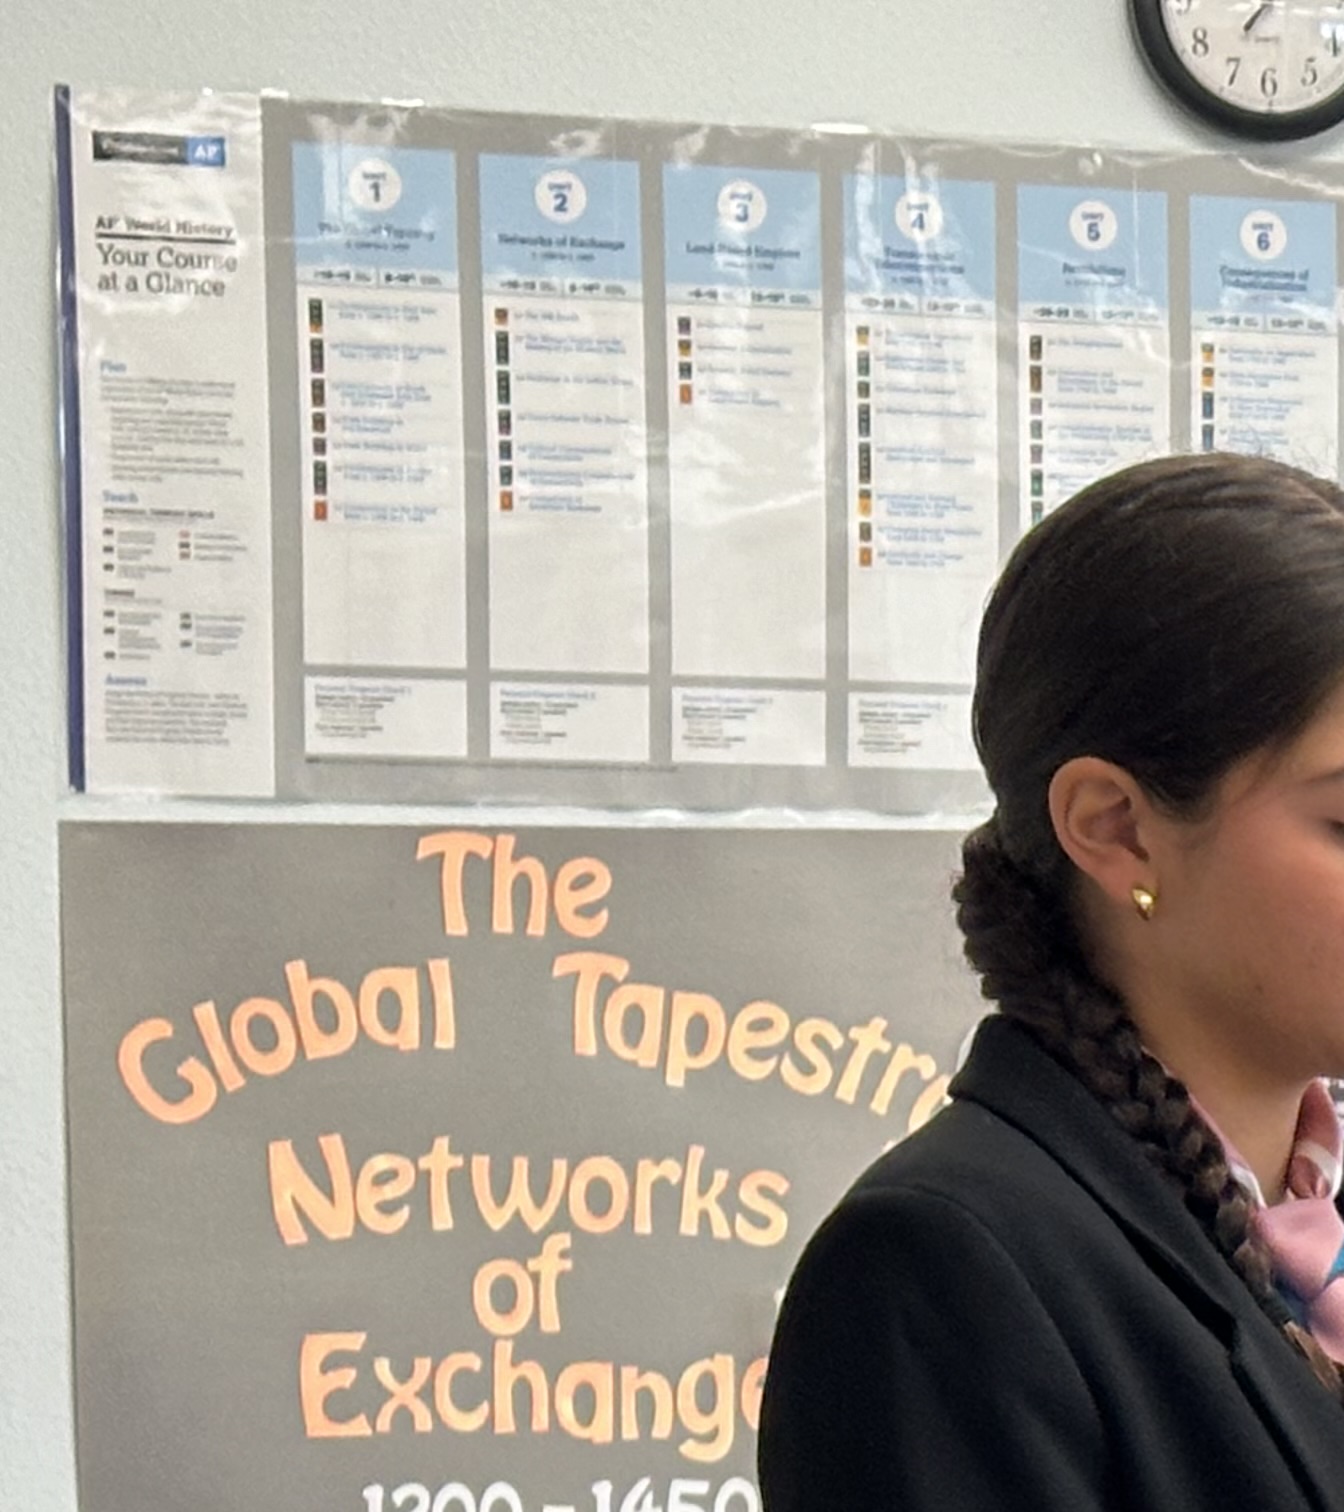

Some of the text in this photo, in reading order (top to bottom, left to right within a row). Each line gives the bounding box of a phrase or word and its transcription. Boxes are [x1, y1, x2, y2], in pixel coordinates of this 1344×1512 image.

[1191, 27, 1210, 57] 8
[1225, 57, 1241, 87] 7
[1260, 68, 1278, 97] 6
[1301, 57, 1318, 87] 5
[369, 181, 380, 203] 1
[553, 193, 569, 213] 2
[735, 203, 749, 222] 3
[911, 212, 925, 231] 4
[1087, 222, 1101, 242] 5
[1256, 233, 1271, 252] 6
[96, 242, 149, 268] Your
[97, 271, 226, 298] at a Glance
[416, 831, 612, 938] The
[117, 958, 457, 1125] Global
[267, 1134, 791, 1247] Networks
[472, 1233, 572, 1335] of
